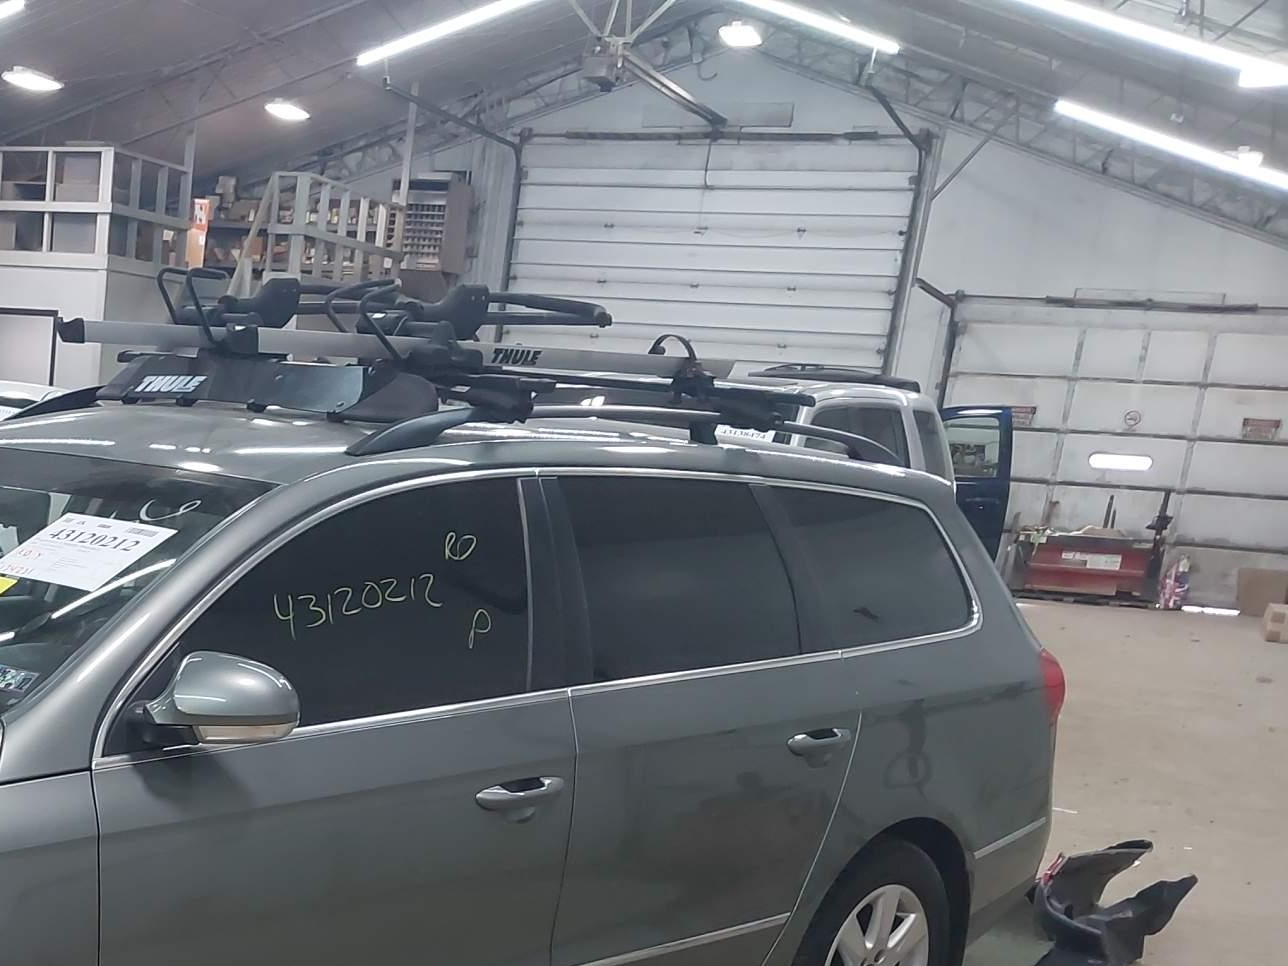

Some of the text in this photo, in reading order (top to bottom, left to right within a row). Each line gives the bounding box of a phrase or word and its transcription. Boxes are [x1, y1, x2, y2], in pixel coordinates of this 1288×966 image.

[491, 347, 543, 366] THULE
[134, 375, 208, 392] THULE
[50, 528, 141, 552] 43120212
[273, 573, 443, 641] 43120212
